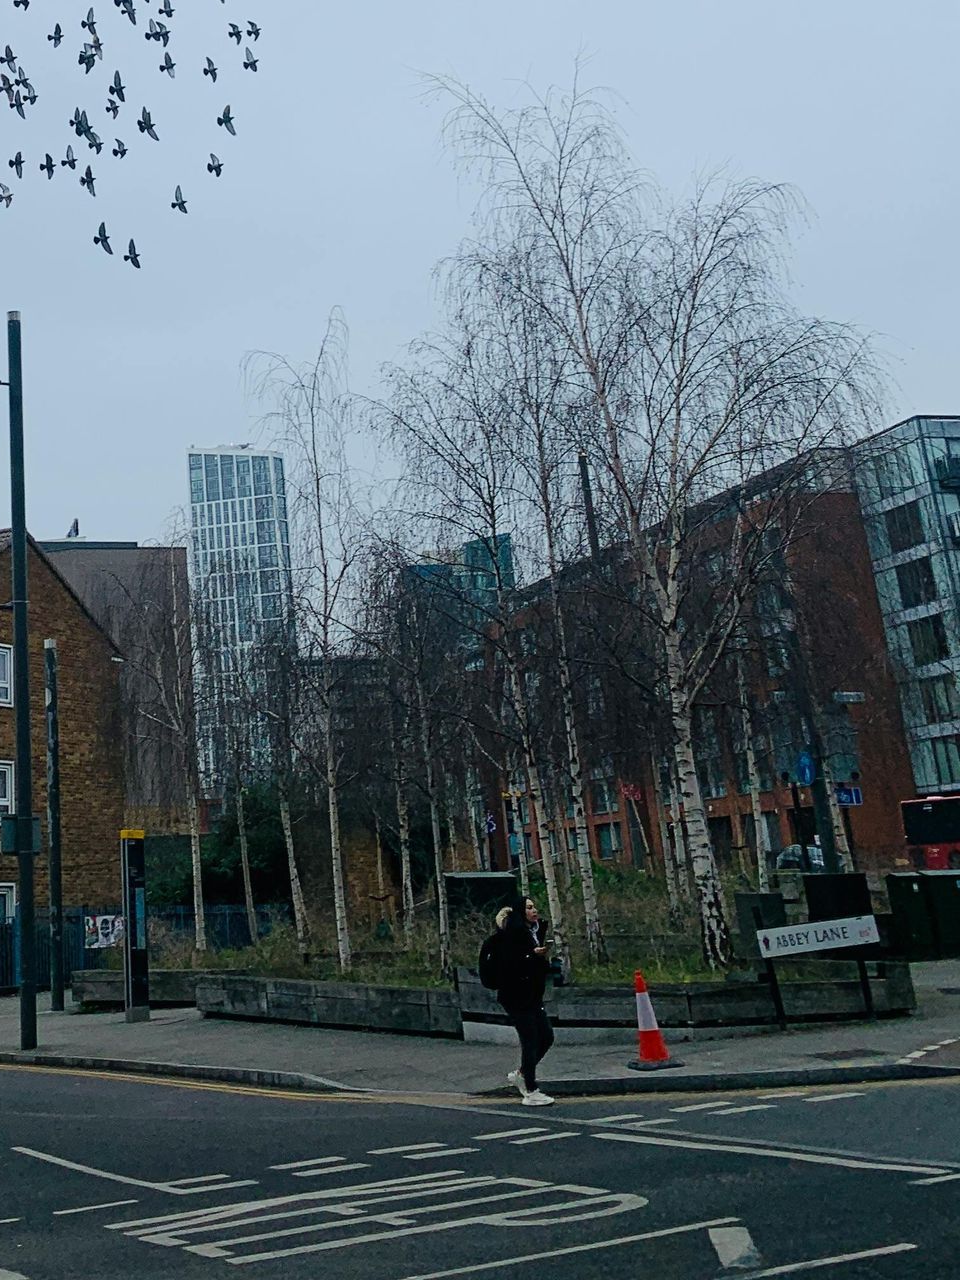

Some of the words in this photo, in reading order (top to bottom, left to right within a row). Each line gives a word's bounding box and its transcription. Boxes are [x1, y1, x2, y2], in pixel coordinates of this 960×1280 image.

[776, 930, 810, 949] ABBEY
[814, 926, 849, 943] LANE
[103, 1169, 650, 1263] KEEP
